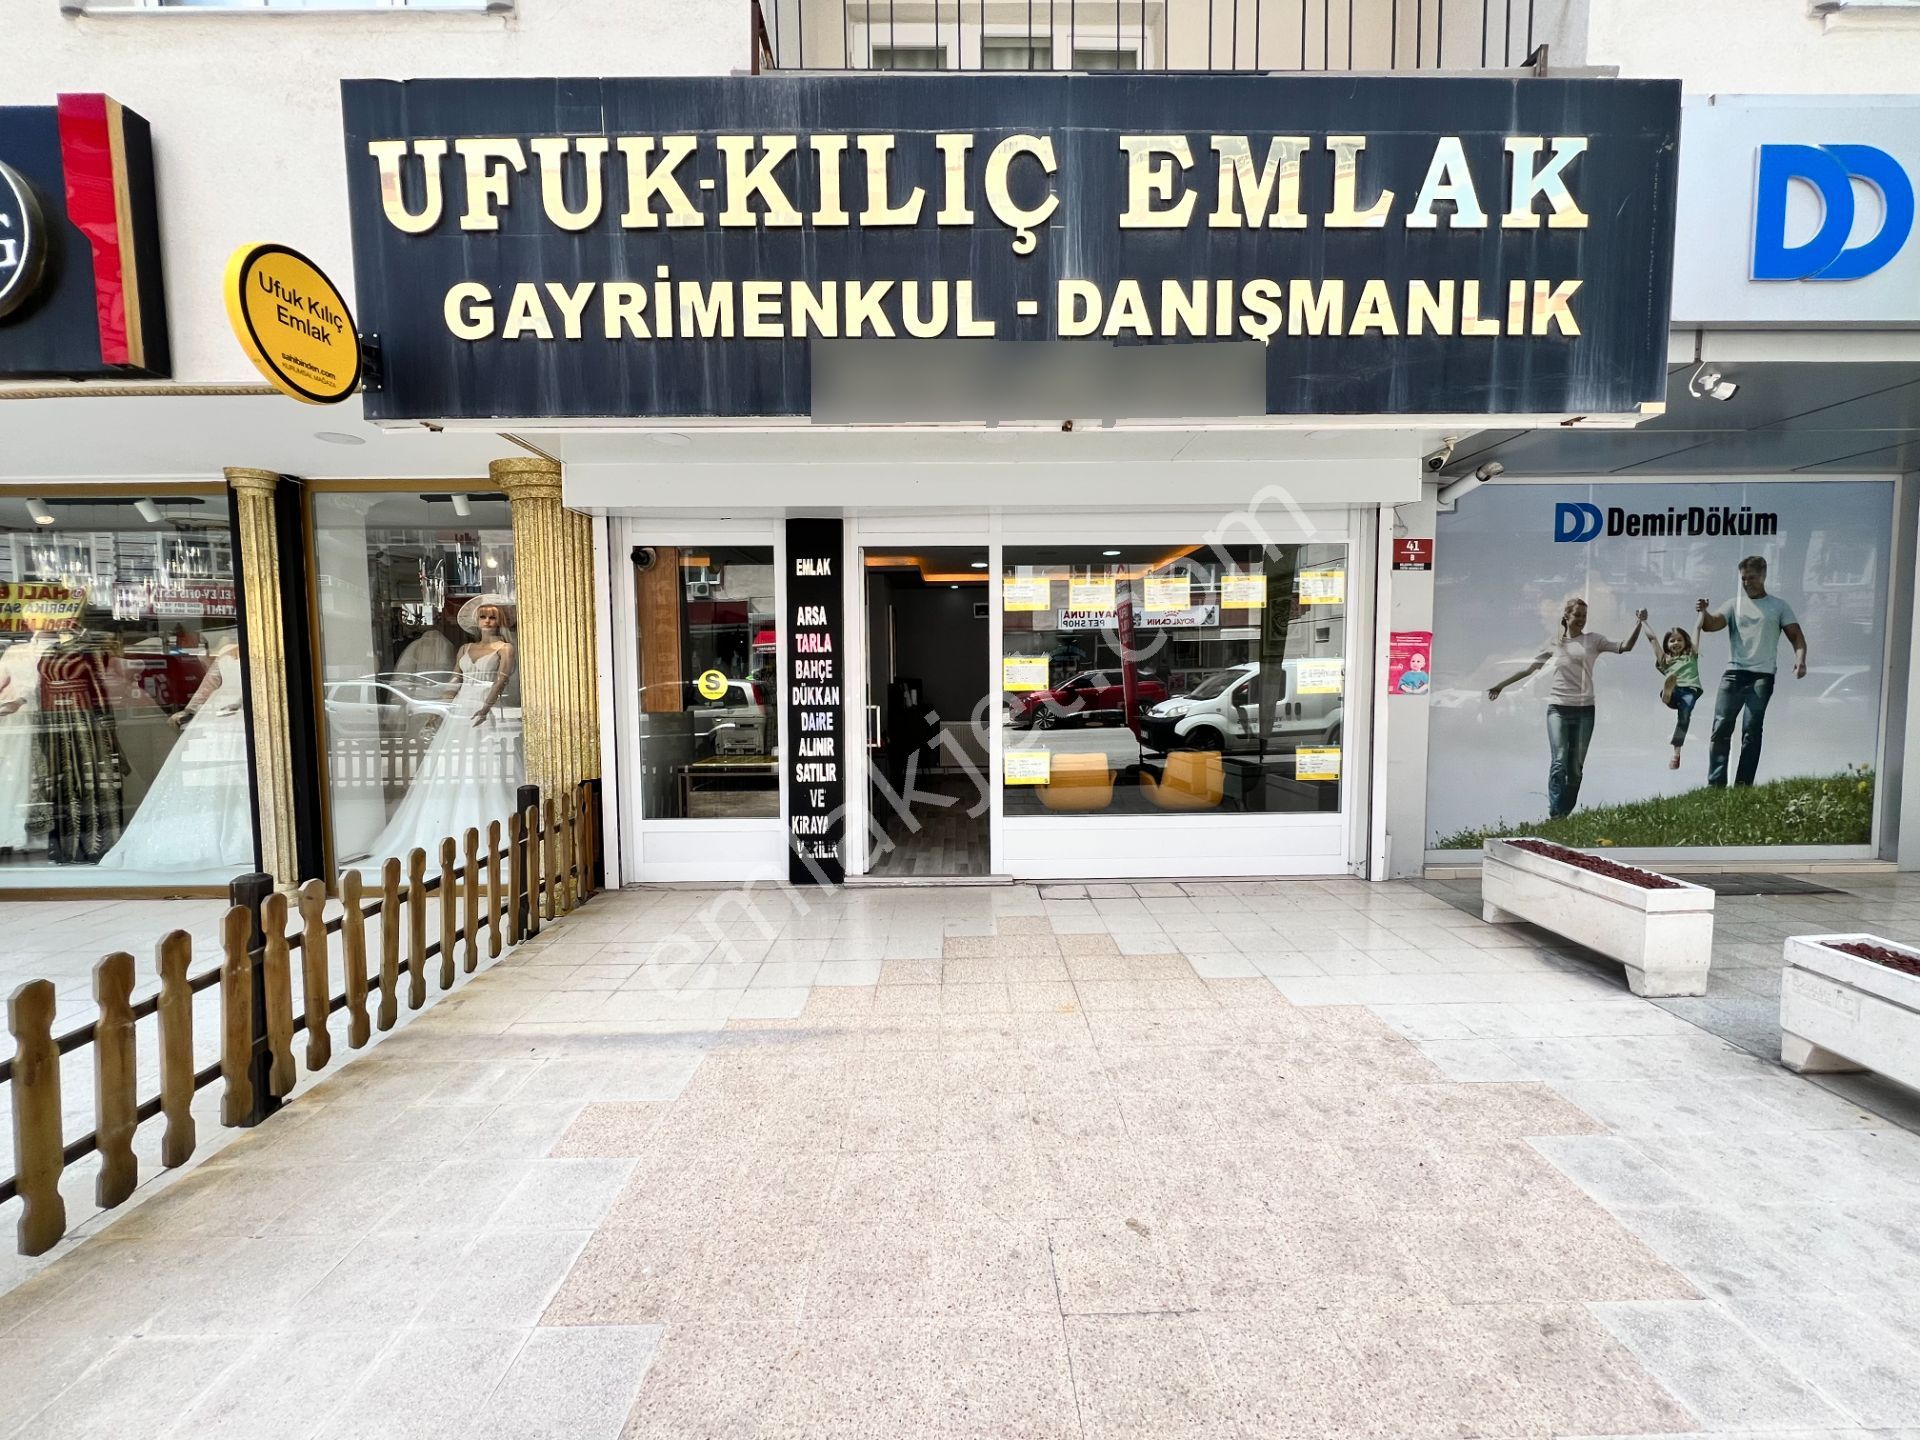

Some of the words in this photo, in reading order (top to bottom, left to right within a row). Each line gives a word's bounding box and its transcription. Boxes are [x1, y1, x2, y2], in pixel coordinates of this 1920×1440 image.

[1118, 134, 1590, 230] EMLAK
[258, 270, 304, 311] Ufuk
[307, 296, 344, 334] Kılıç
[442, 264, 996, 342] GAYRİMENKUL
[1057, 278, 1585, 348] DANIŞMANLIK
[275, 304, 332, 346] Emlak
[281, 352, 337, 381] sahibinden.com
[1607, 506, 1778, 537] DemirDöküm
[1406, 540, 1420, 552] 41
[795, 557, 832, 576] EMLAK
[796, 605, 828, 627] ARSA
[795, 632, 833, 654] TARLA
[795, 659, 833, 684] BAHÇE
[792, 683, 840, 706] DÜKKAN
[798, 737, 835, 757] ALINIR
[795, 762, 837, 783] SATILIR
[809, 788, 826, 808] VE
